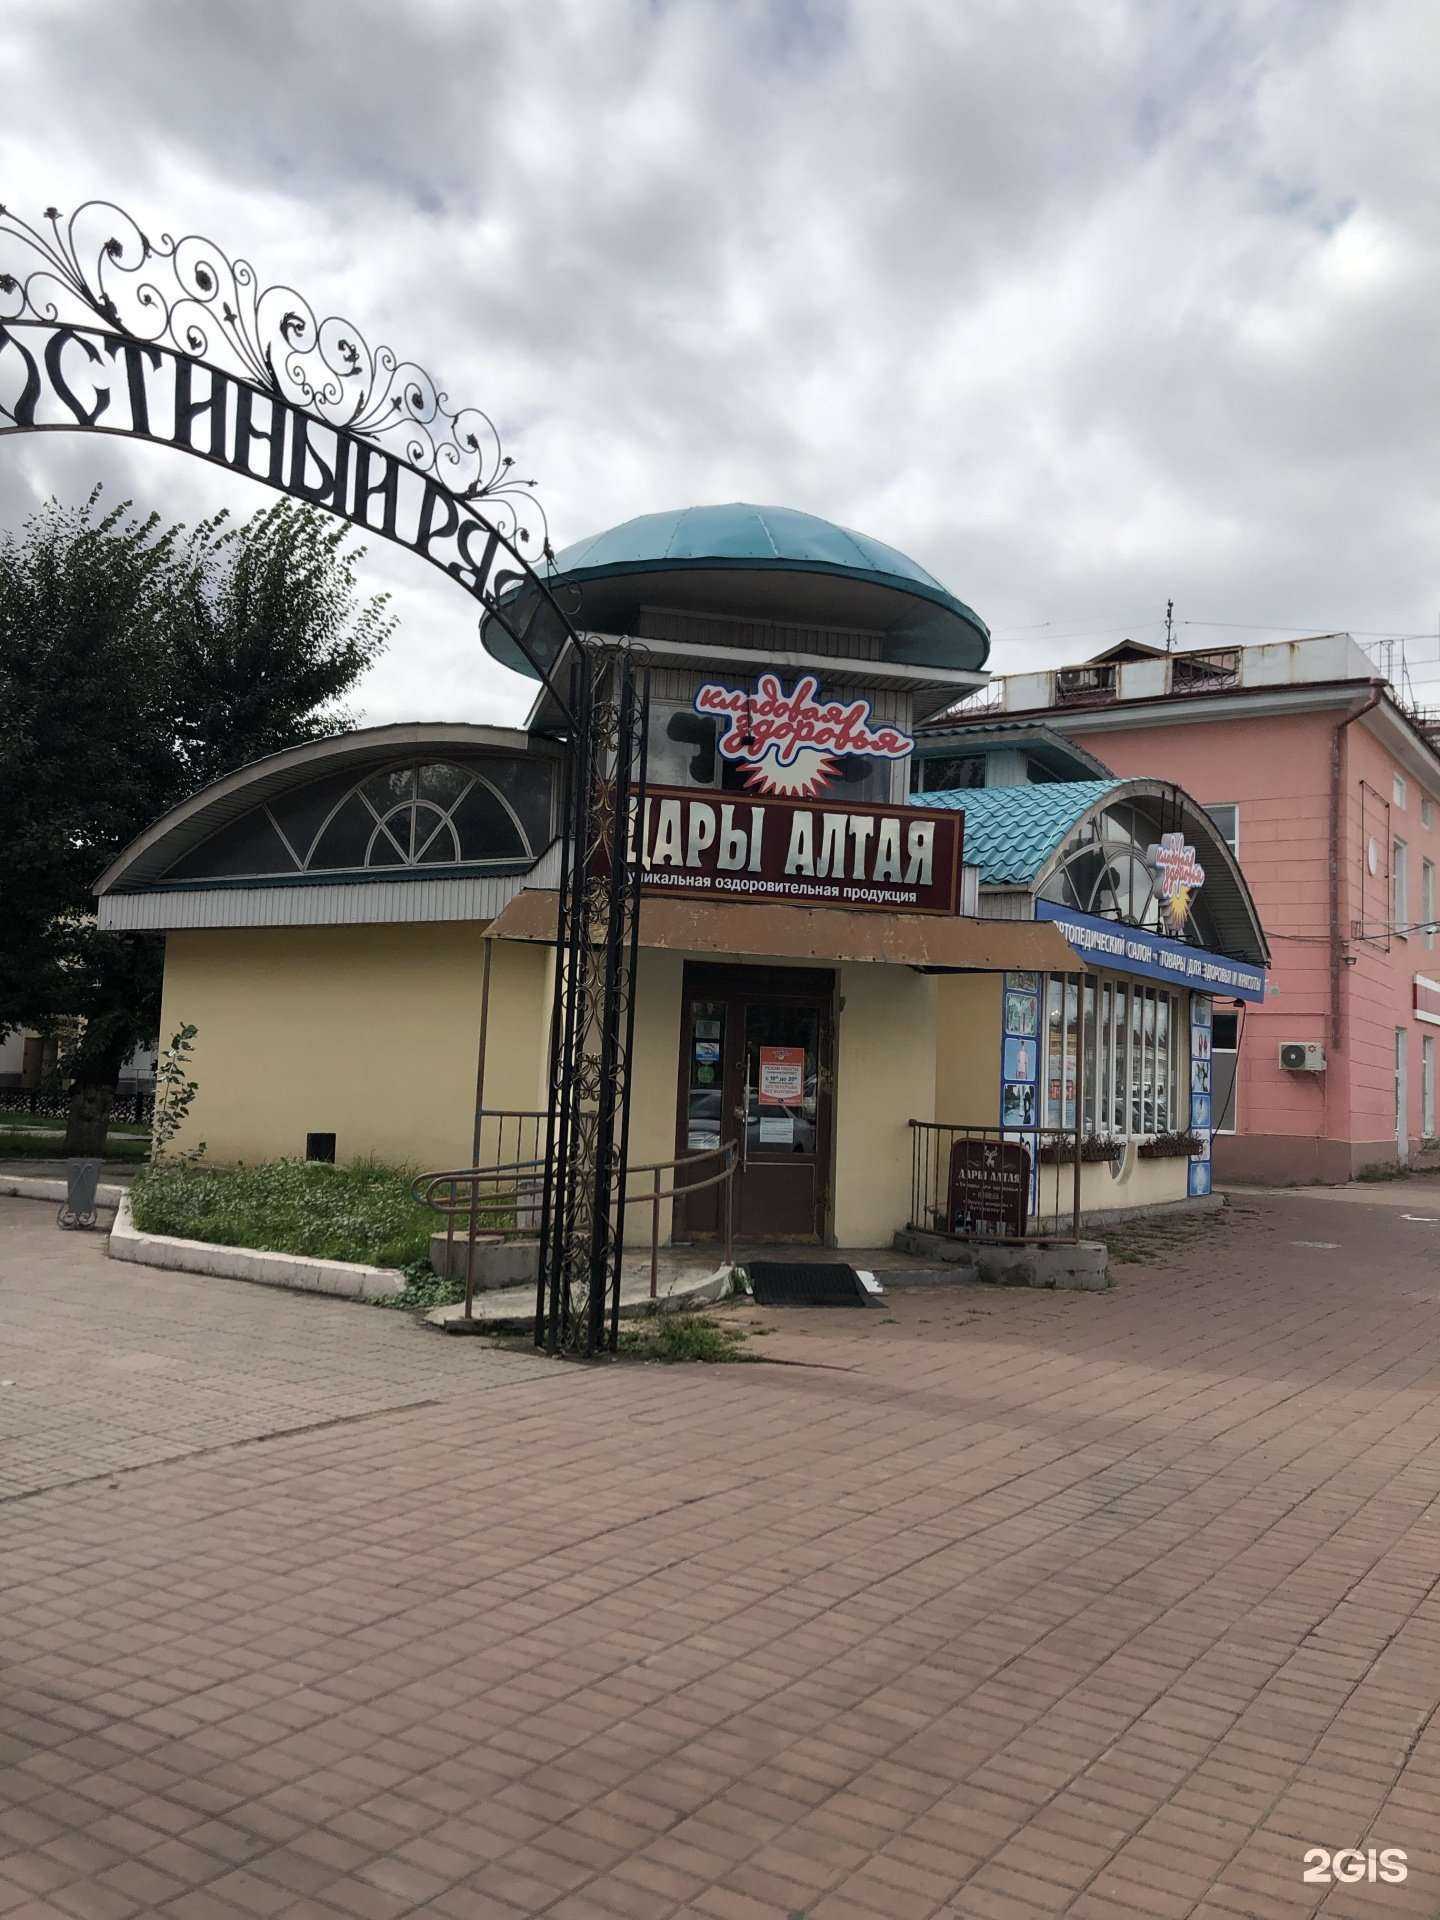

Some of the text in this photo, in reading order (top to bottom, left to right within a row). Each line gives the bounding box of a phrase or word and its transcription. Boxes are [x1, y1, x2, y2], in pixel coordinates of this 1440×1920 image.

[700, 678, 843, 724] кладовая
[723, 703, 910, 760] здоровья
[783, 810, 936, 886] АЛТАЯ
[627, 871, 917, 905] уикальная оздоровительная продукция
[1053, 920, 1125, 954] РТОПЕДИЧЕСКИЙ
[1127, 942, 1152, 962] САЛОН
[1160, 951, 1186, 971] ТОВАРЫ
[1187, 958, 1202, 977] ДЛЯ
